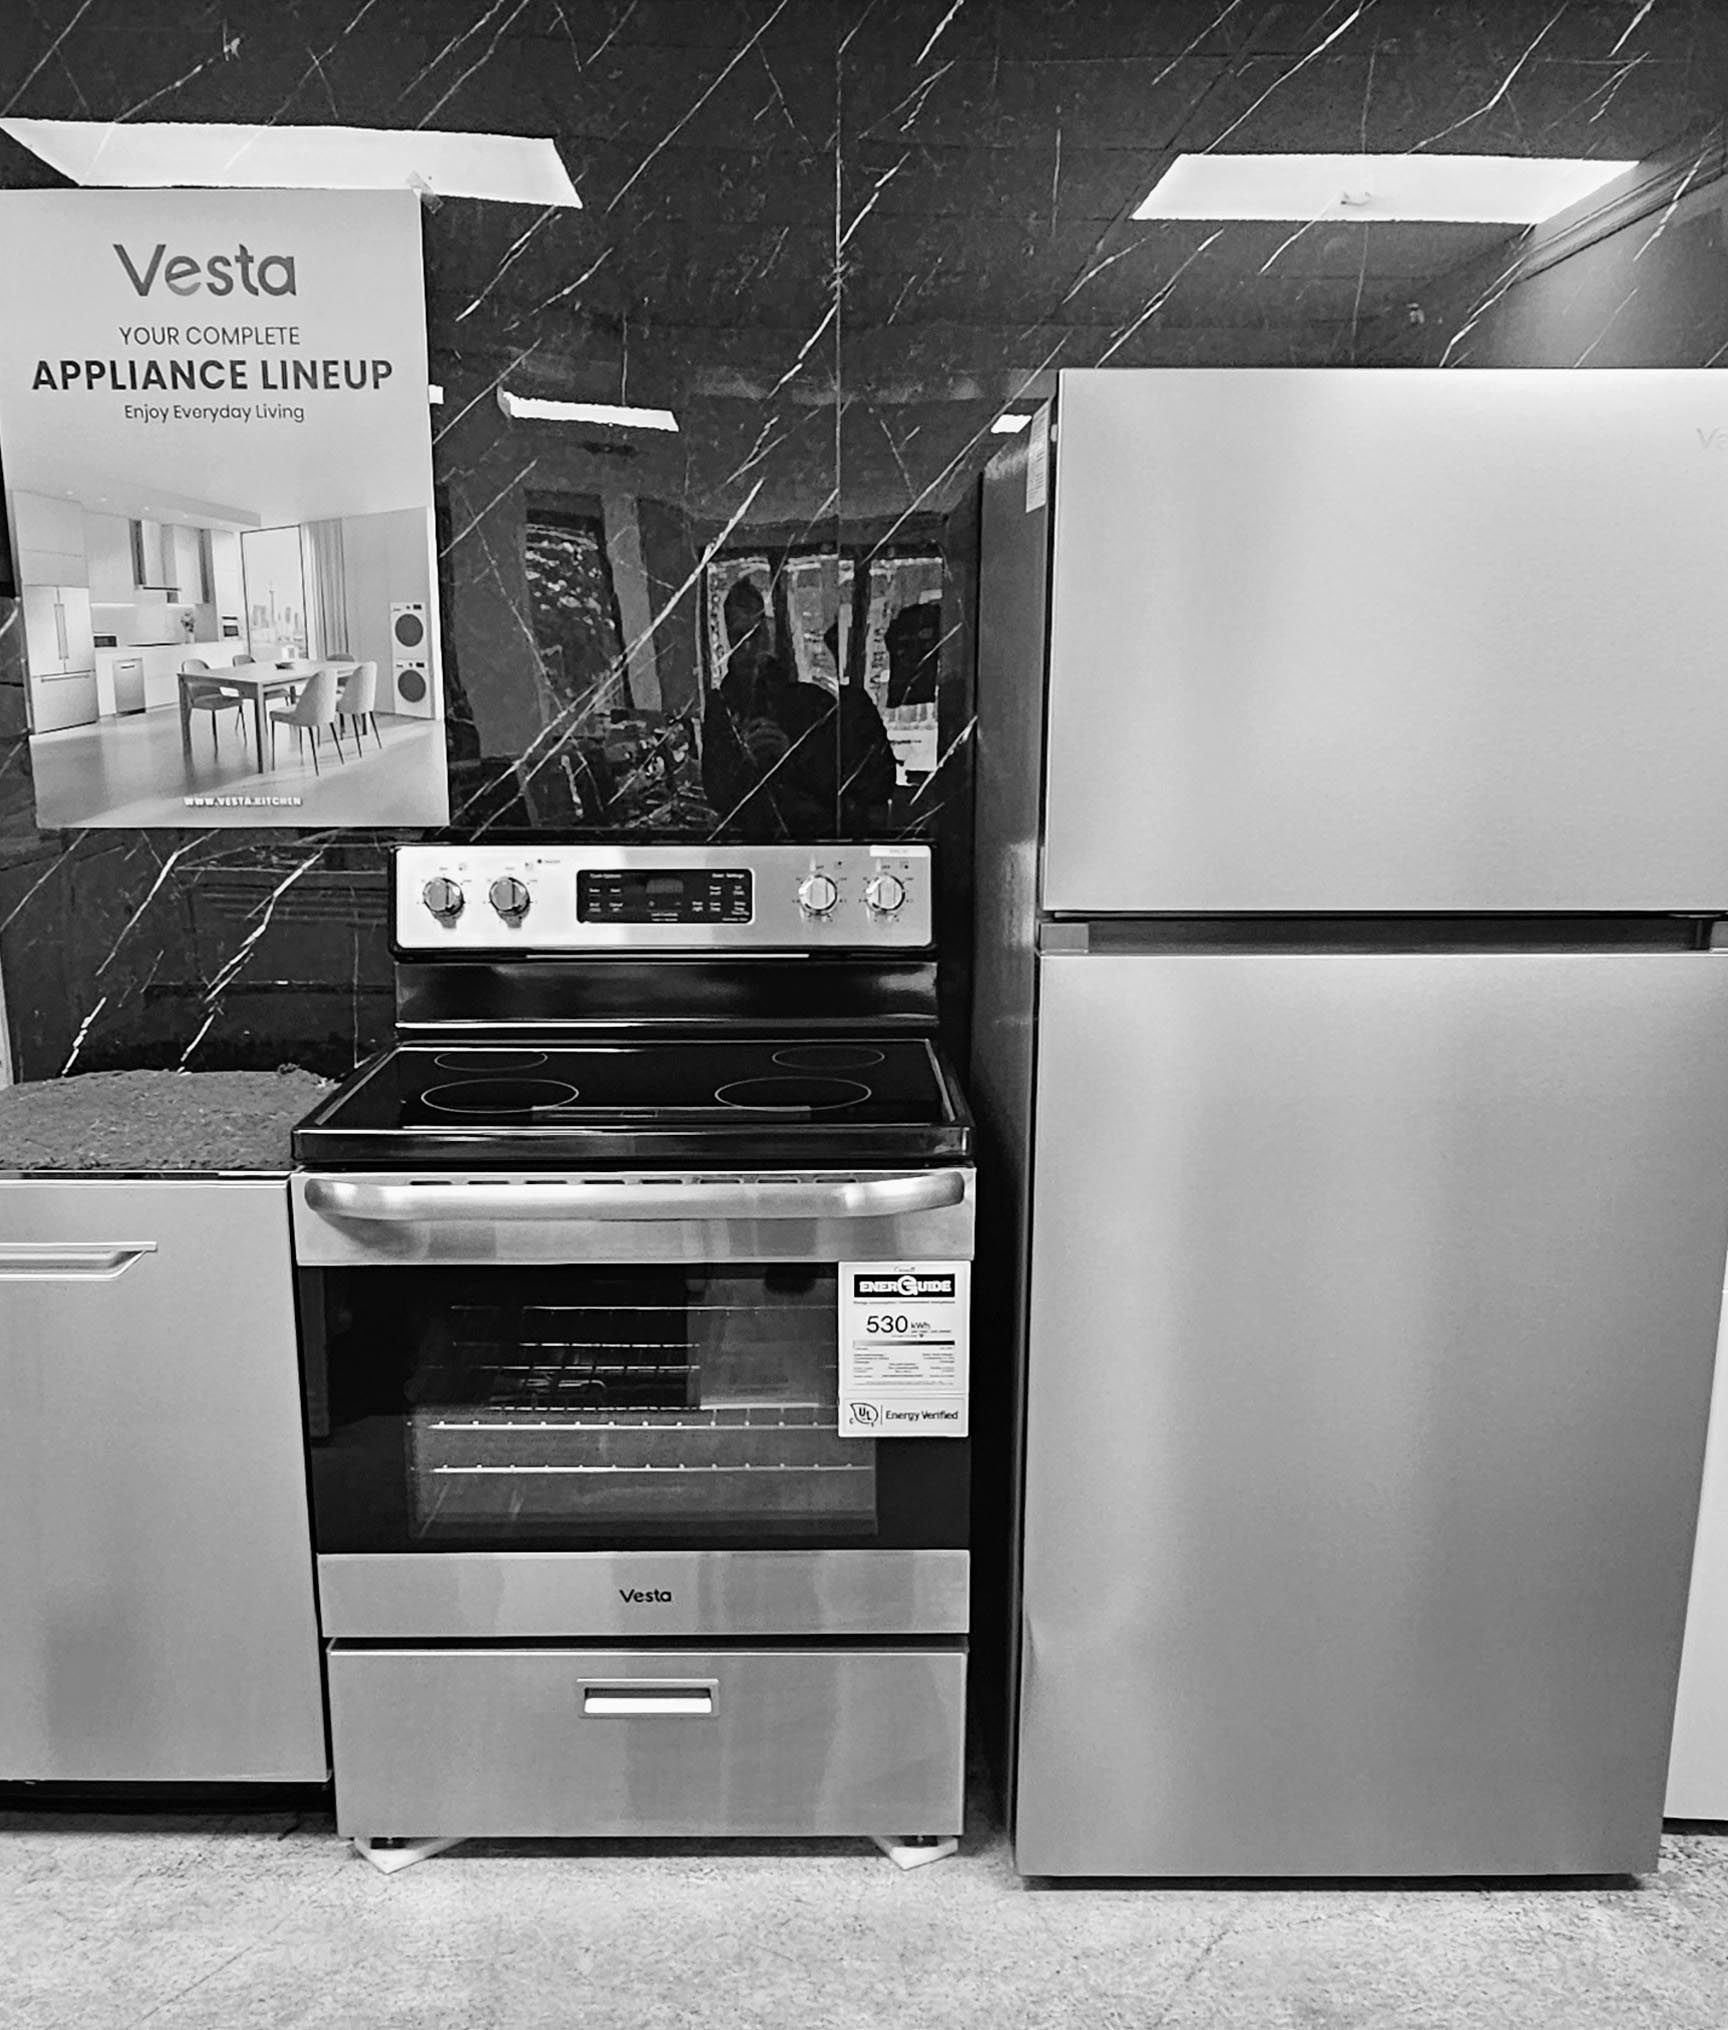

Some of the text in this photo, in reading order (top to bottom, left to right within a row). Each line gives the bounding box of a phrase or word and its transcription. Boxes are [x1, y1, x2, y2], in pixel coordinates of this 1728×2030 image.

[113, 243, 297, 297] Vesta
[118, 326, 301, 345] YOUR COMPLETE
[31, 359, 393, 391] APPLIANCE LINEUP
[124, 404, 305, 423] Enjoy Everyday Living
[619, 588, 672, 603] Vesta
[859, 1275, 952, 1296] ENERGUIDE
[866, 1315, 931, 1334] 530 kWh
[885, 1410, 959, 1422] Energy Verified
